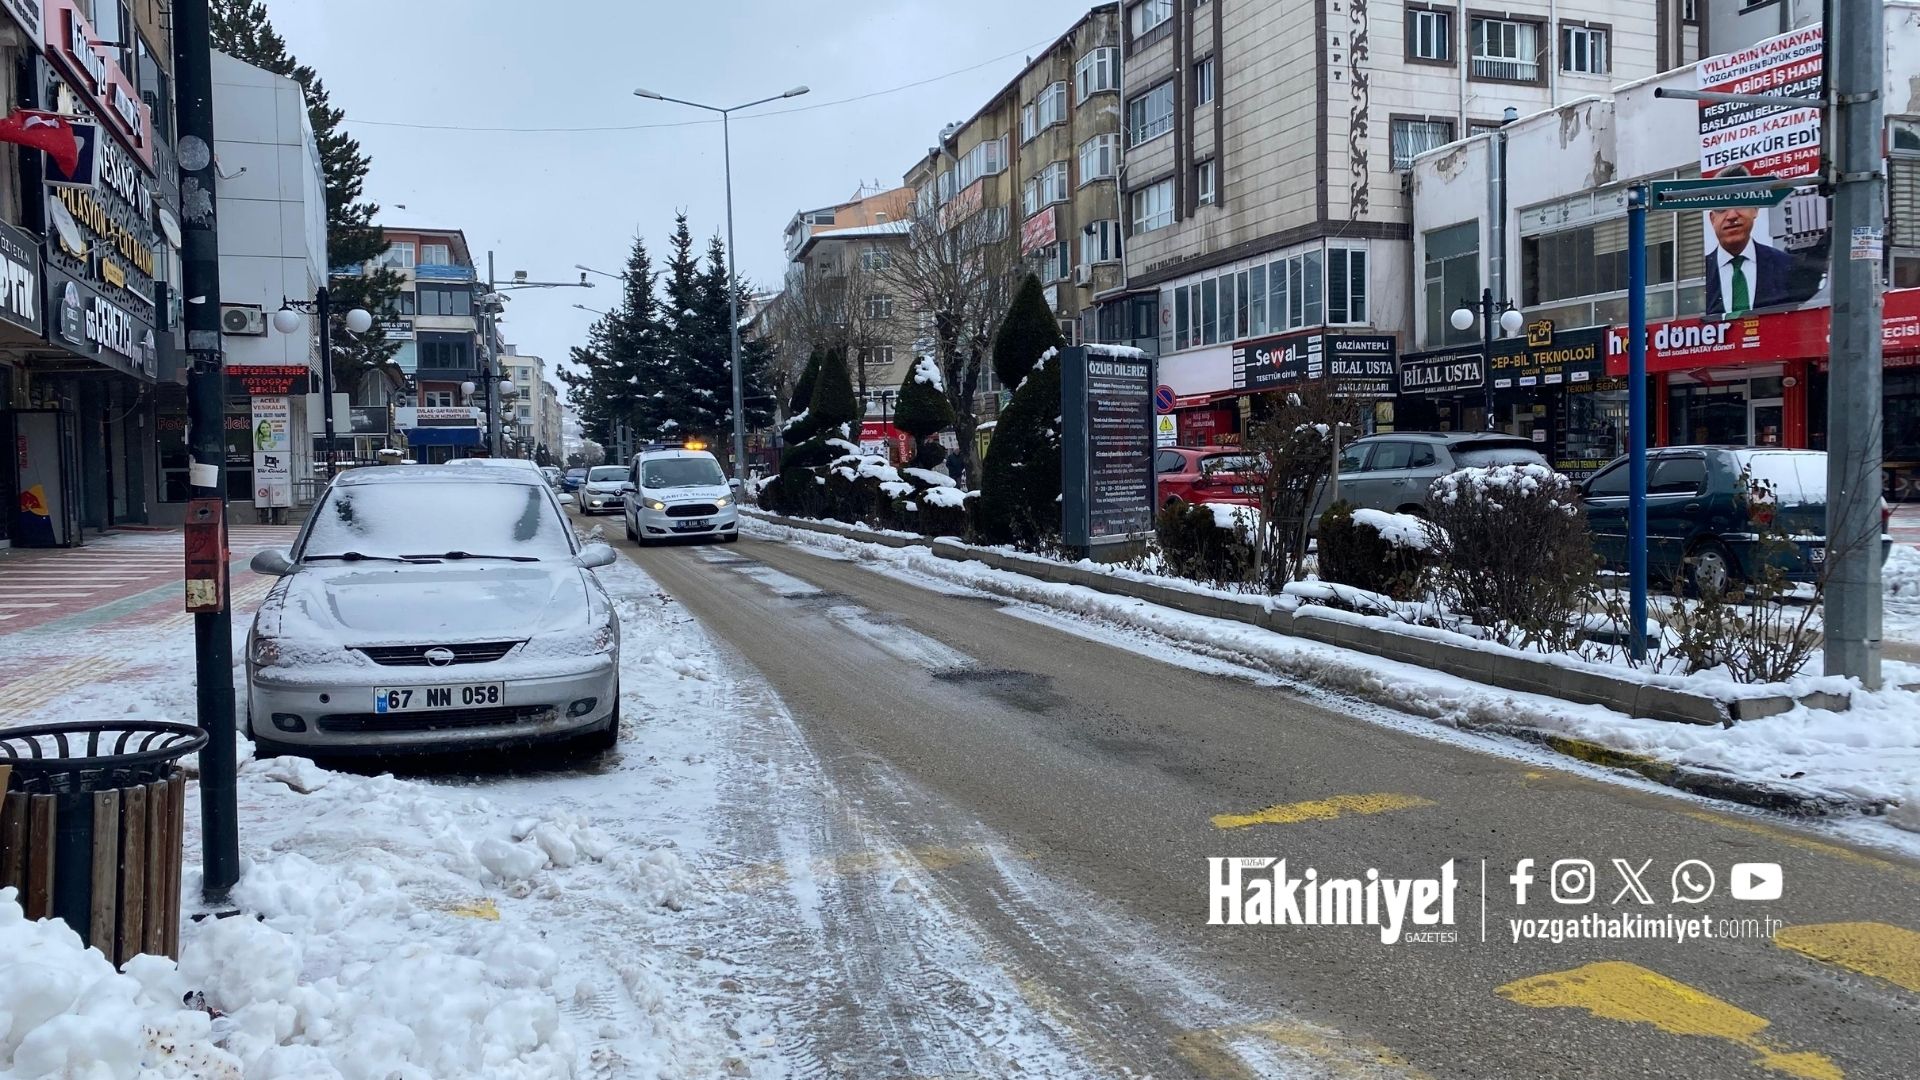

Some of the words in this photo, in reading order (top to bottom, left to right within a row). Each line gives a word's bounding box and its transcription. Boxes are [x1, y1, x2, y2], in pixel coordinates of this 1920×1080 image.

[1703, 48, 1759, 74] YILLARIN
[1760, 28, 1822, 57] KANAYAN
[1702, 66, 1748, 85] YOZGAT'IN
[1749, 62, 1760, 71] EN
[1762, 52, 1791, 67] BÜYÜK
[1793, 43, 1822, 57] SORUN
[1733, 73, 1771, 95] ABİDE
[1773, 68, 1786, 85] İŞ
[1701, 111, 1754, 132] BAŞLATAN
[1702, 130, 1740, 148] SAYIN
[1740, 126, 1760, 139] DR.
[1763, 111, 1805, 132] KAZIM
[1705, 135, 1784, 167] TEŞEKKÜR
[1752, 156, 1780, 171] ABİDE
[1782, 152, 1793, 163] İŞ
[1336, 339, 1389, 350] GAZİANTEPLİ
[1654, 322, 1732, 350] döner
[1533, 343, 1595, 365] TEKNOLOJİ
[1689, 344, 1712, 354] HATAY
[1088, 360, 1113, 375] ÖZÜR
[1114, 363, 1147, 377] DİLERİZ!
[1331, 357, 1363, 374] BİLAL
[1366, 361, 1393, 375] USTA
[1404, 365, 1441, 387] BİLAL
[1445, 362, 1480, 383] USTA
[1596, 380, 1627, 391] SERVİS
[388, 689, 413, 709] 67
[427, 687, 451, 707] NN
[462, 685, 498, 705] 058
